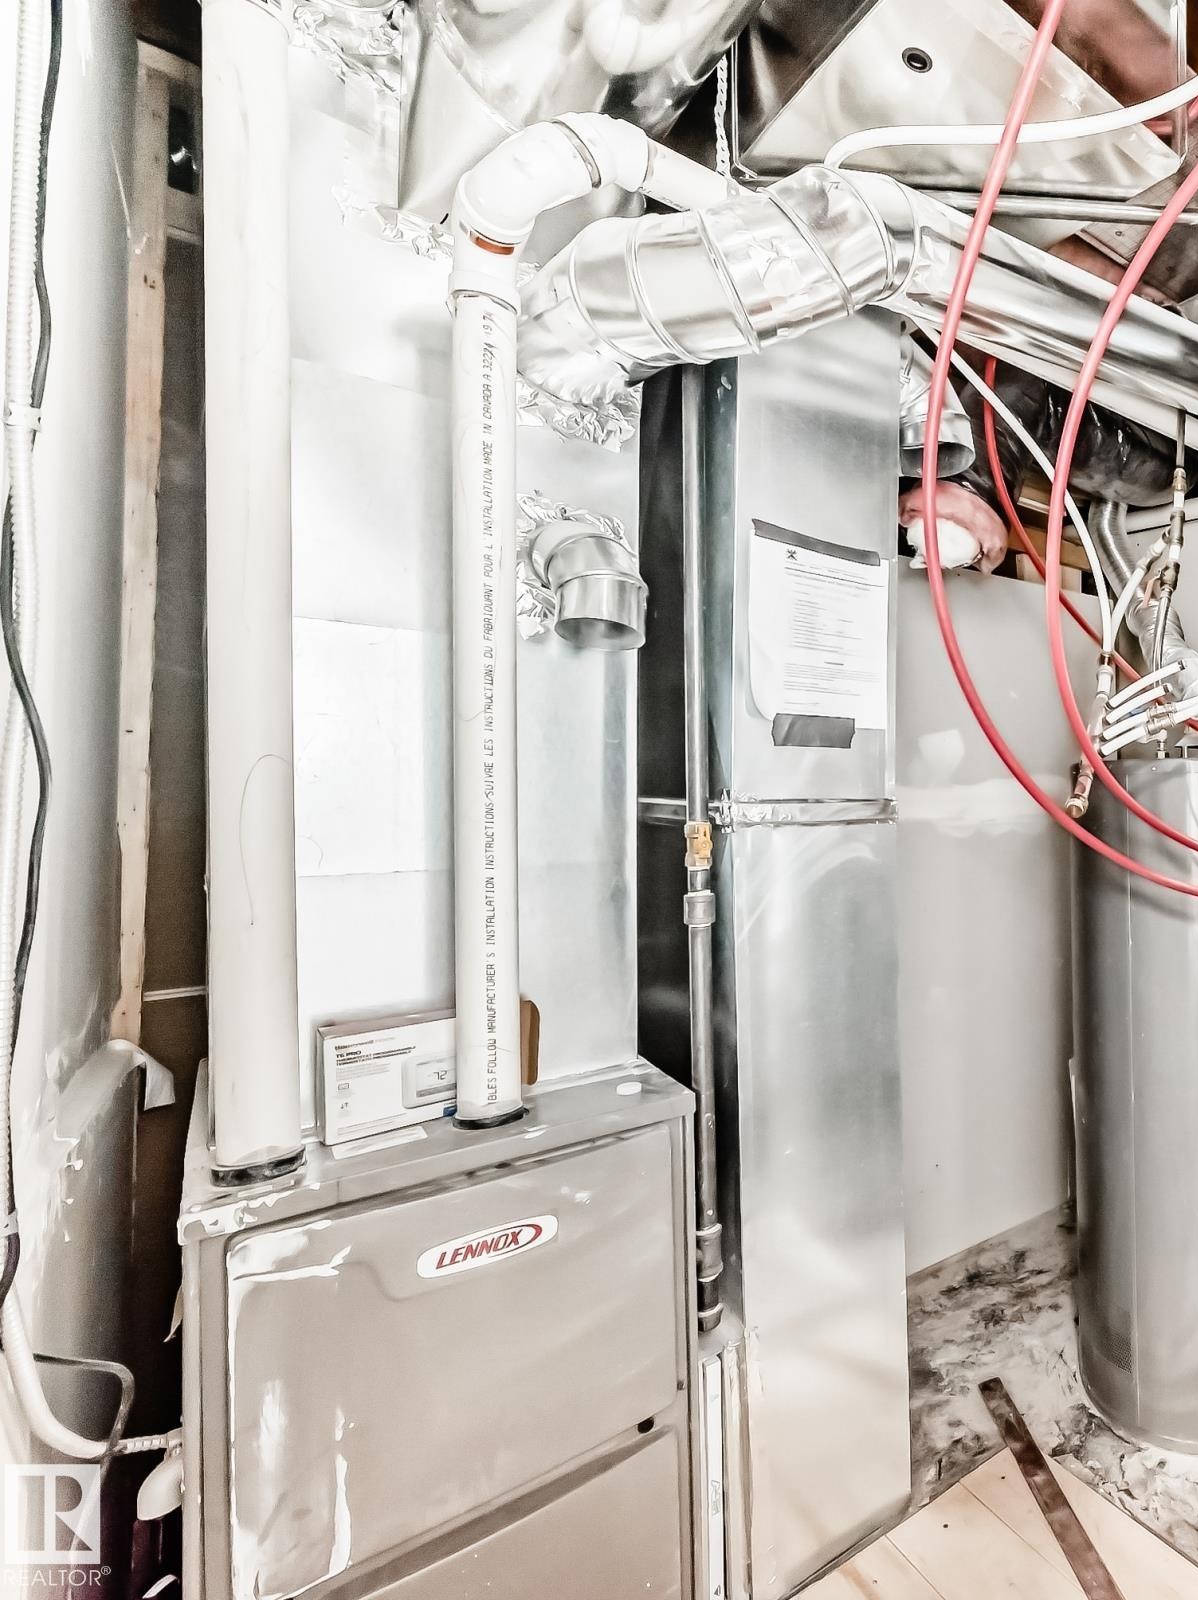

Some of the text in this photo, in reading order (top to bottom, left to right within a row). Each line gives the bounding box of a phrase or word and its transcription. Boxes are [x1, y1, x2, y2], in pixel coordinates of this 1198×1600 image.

[482, 384, 492, 419] CANADA
[482, 424, 492, 434] IN
[482, 441, 493, 466] MADE
[483, 554, 493, 577] POUR
[483, 646, 494, 659] DU
[483, 663, 494, 732] INSTRUCTIONS
[484, 738, 494, 757] LES
[484, 876, 496, 945] INSTALLATION
[486, 1038, 497, 1074] FOLLOW
[433, 1070, 448, 1081] 72
[435, 1228, 524, 1270] LENNOX
